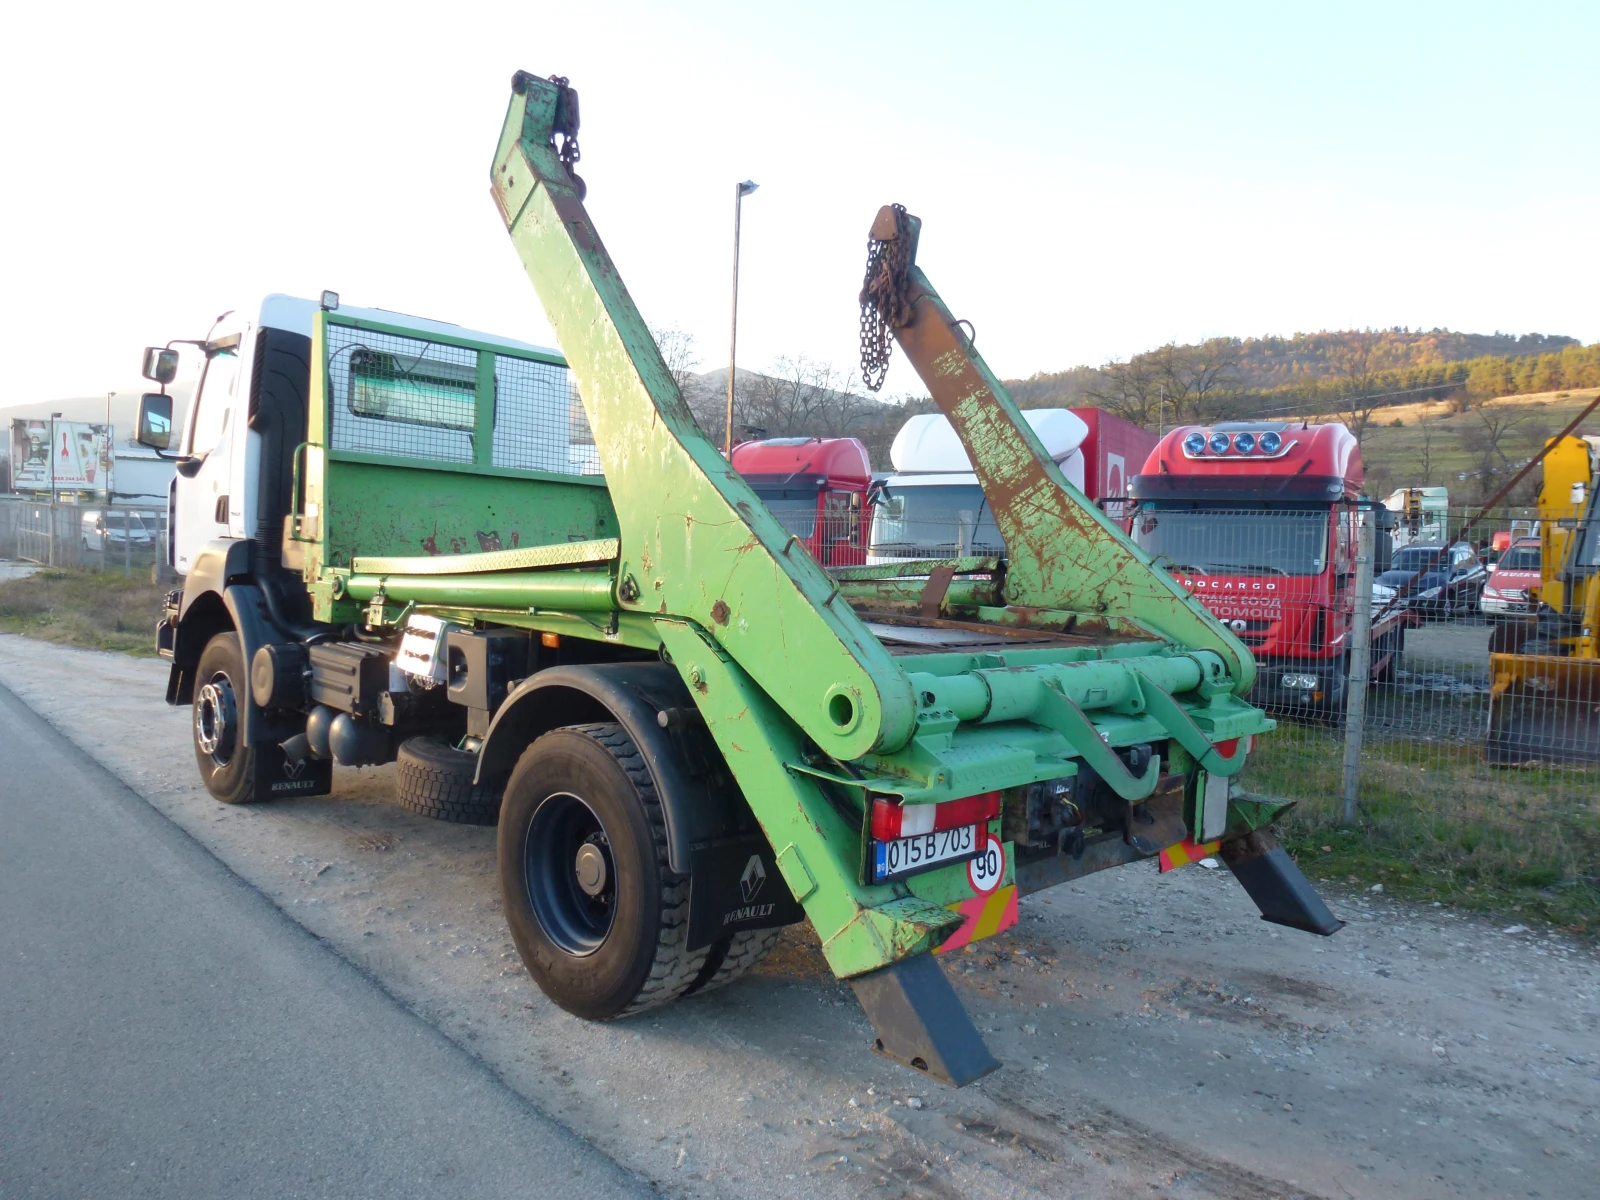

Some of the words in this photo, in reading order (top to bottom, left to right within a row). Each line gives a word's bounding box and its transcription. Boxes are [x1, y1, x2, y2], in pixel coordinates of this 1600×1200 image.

[1176, 579, 1276, 590] ROCARGO
[271, 780, 315, 791] RENAULT
[976, 850, 997, 879] 90
[722, 903, 776, 926] RENAULT
